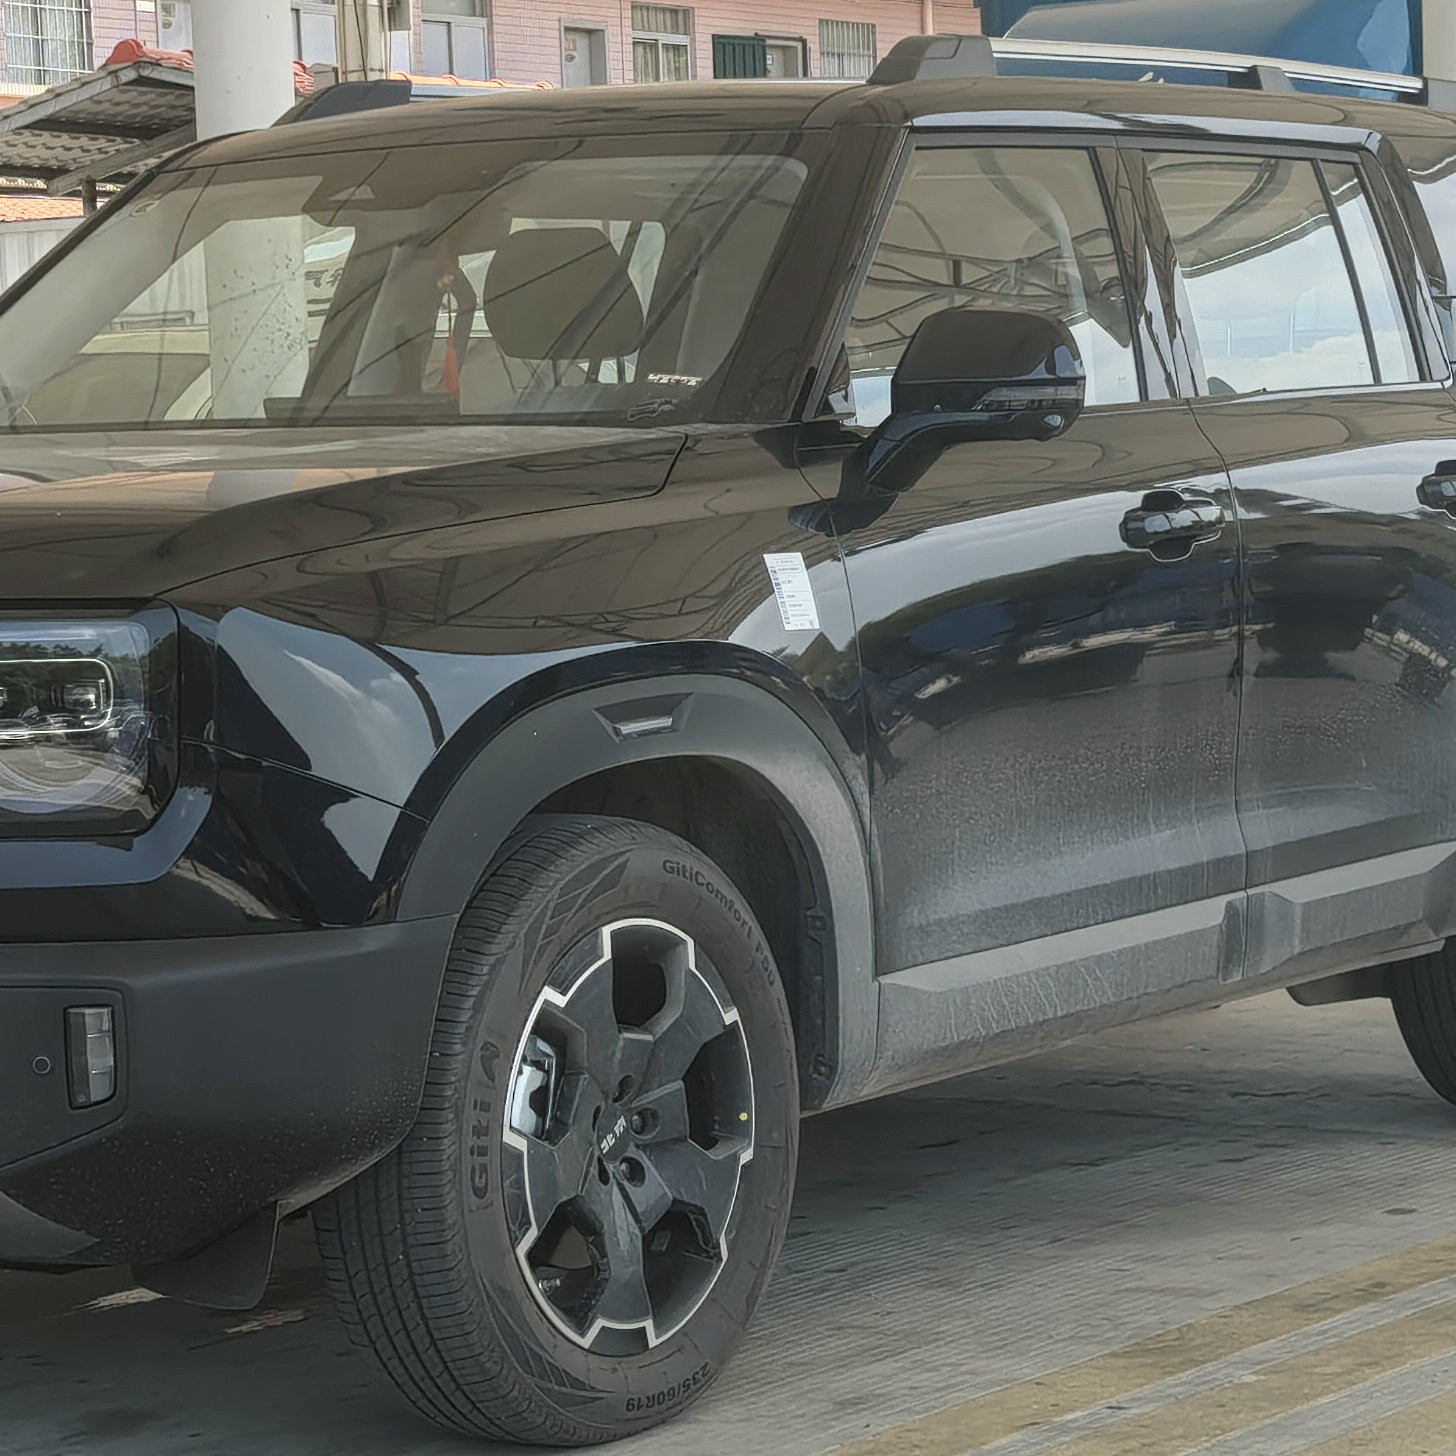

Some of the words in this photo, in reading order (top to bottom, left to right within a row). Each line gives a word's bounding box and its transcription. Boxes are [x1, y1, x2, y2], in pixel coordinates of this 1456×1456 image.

[662, 859, 753, 940] GitiComfort
[469, 1098, 492, 1200] Giti
[626, 1361, 711, 1413] 235/60R19
